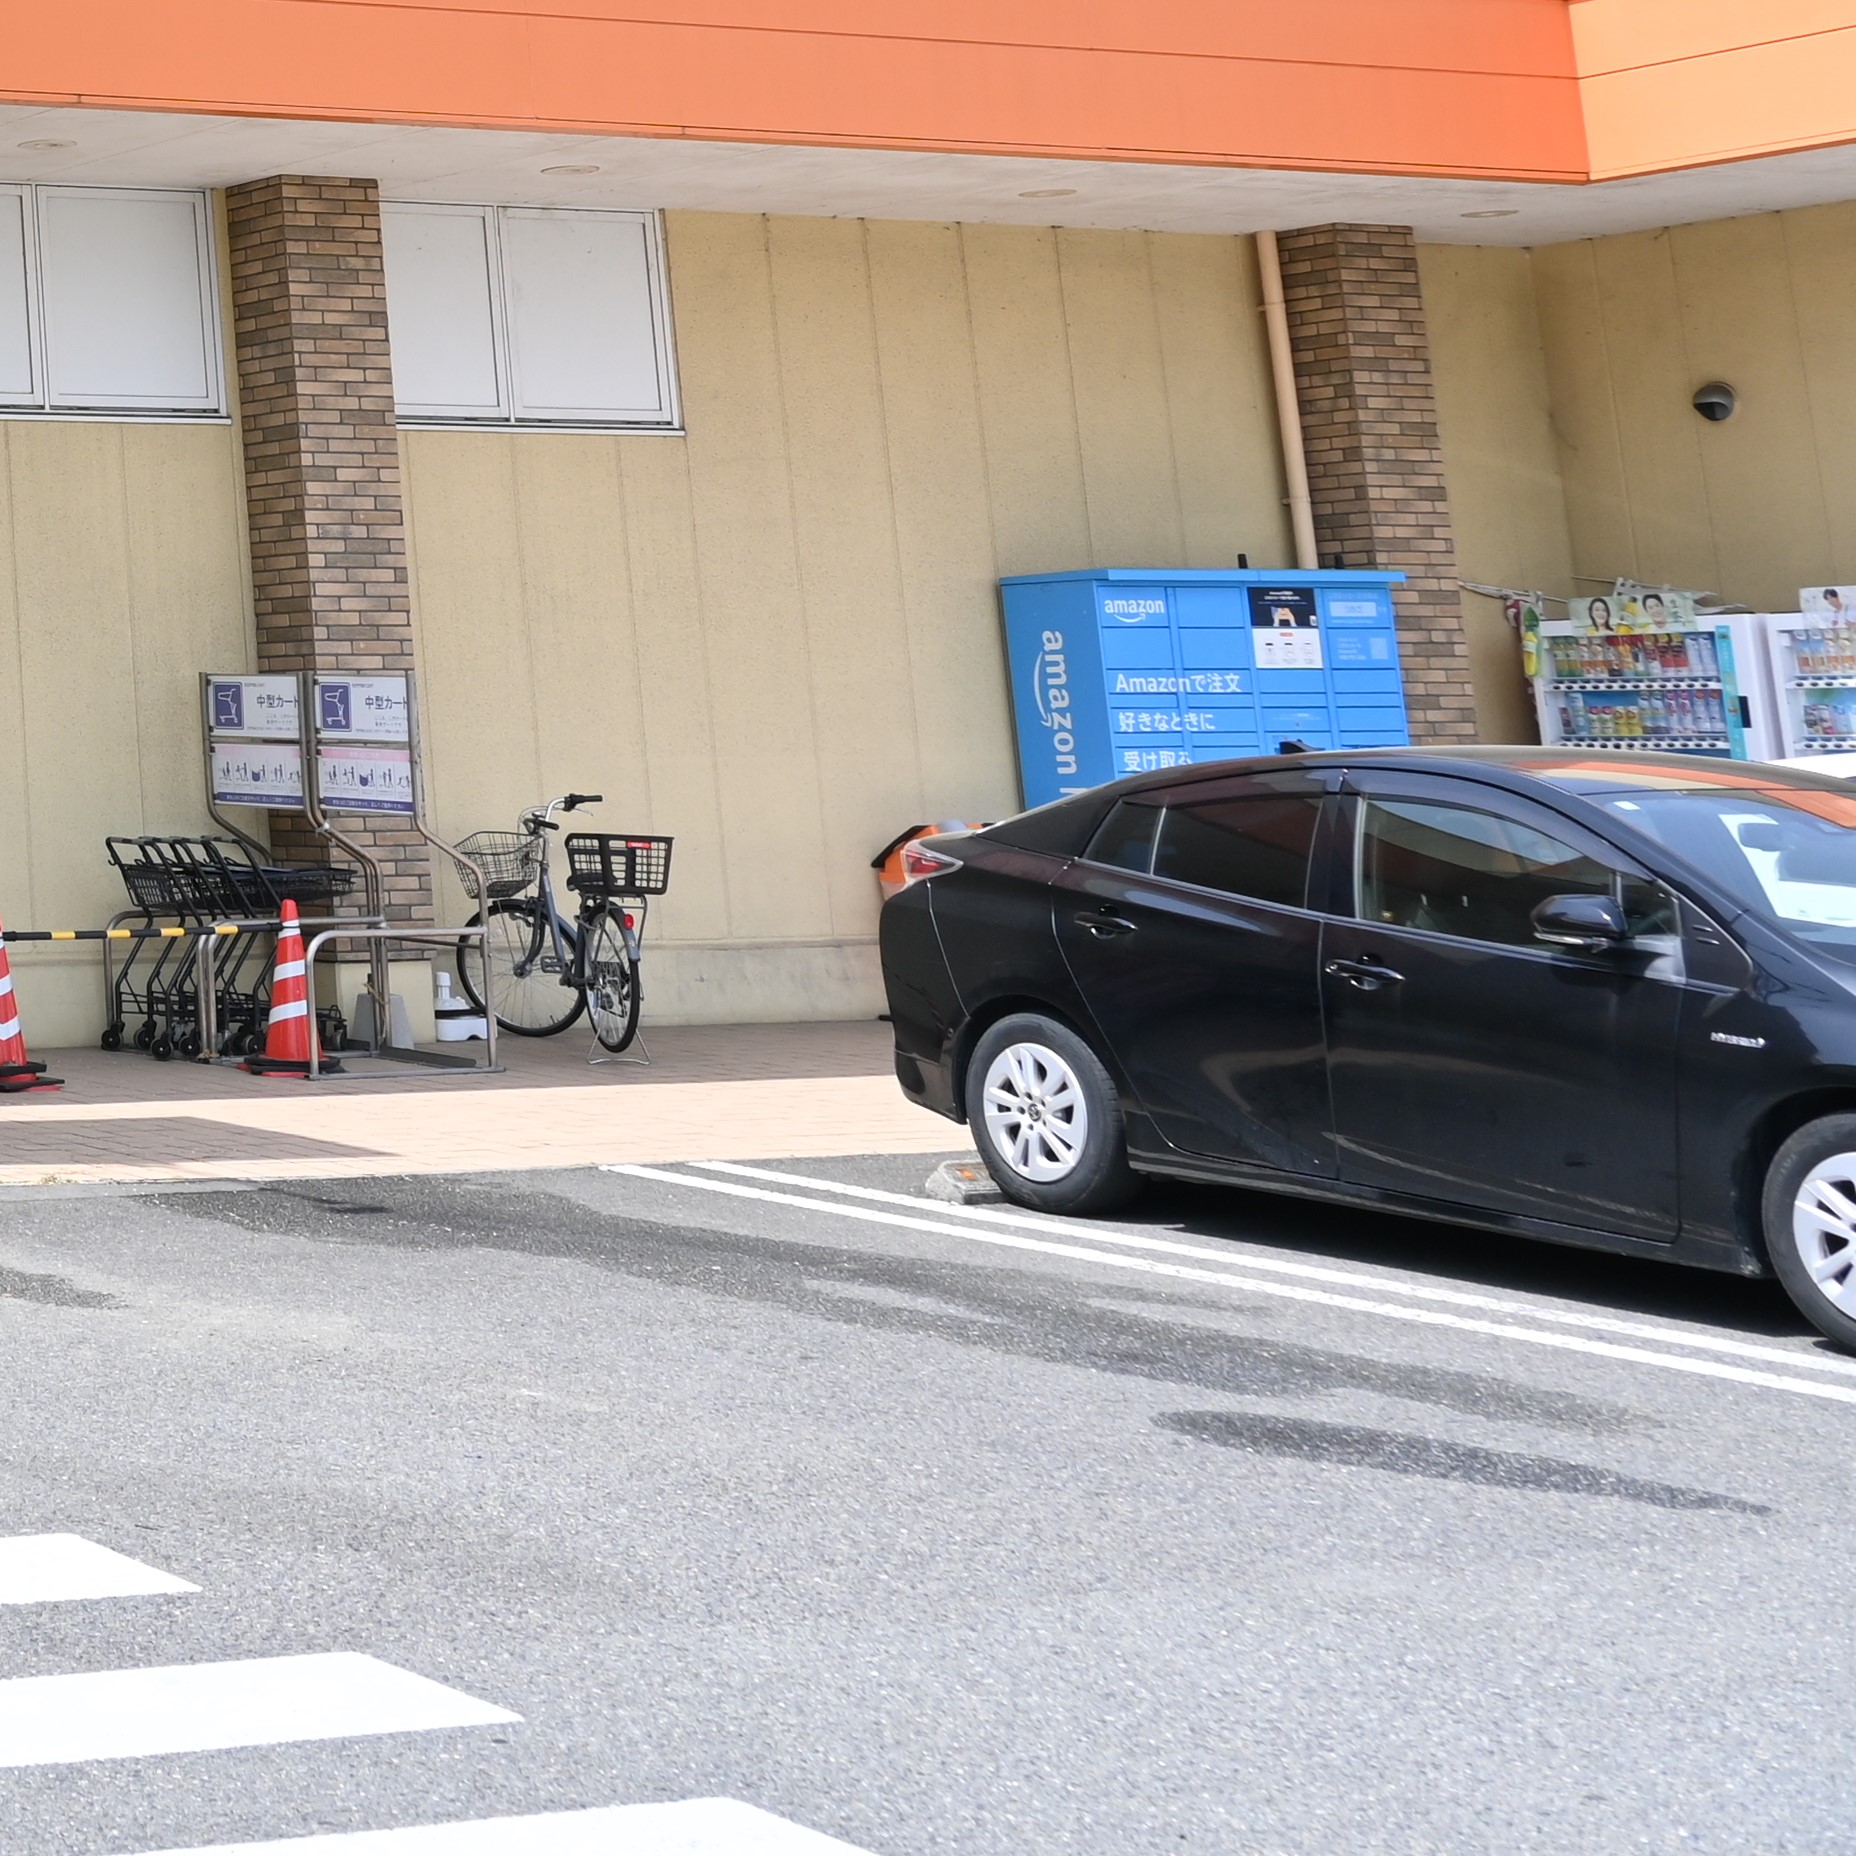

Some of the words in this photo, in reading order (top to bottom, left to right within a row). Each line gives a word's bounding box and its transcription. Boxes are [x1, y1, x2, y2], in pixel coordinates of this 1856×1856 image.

[1103, 598, 1165, 618] amazon
[1115, 673, 1242, 693] Amazonで注文
[1040, 630, 1079, 776] amazon
[1118, 712, 1217, 733] 好きなときに
